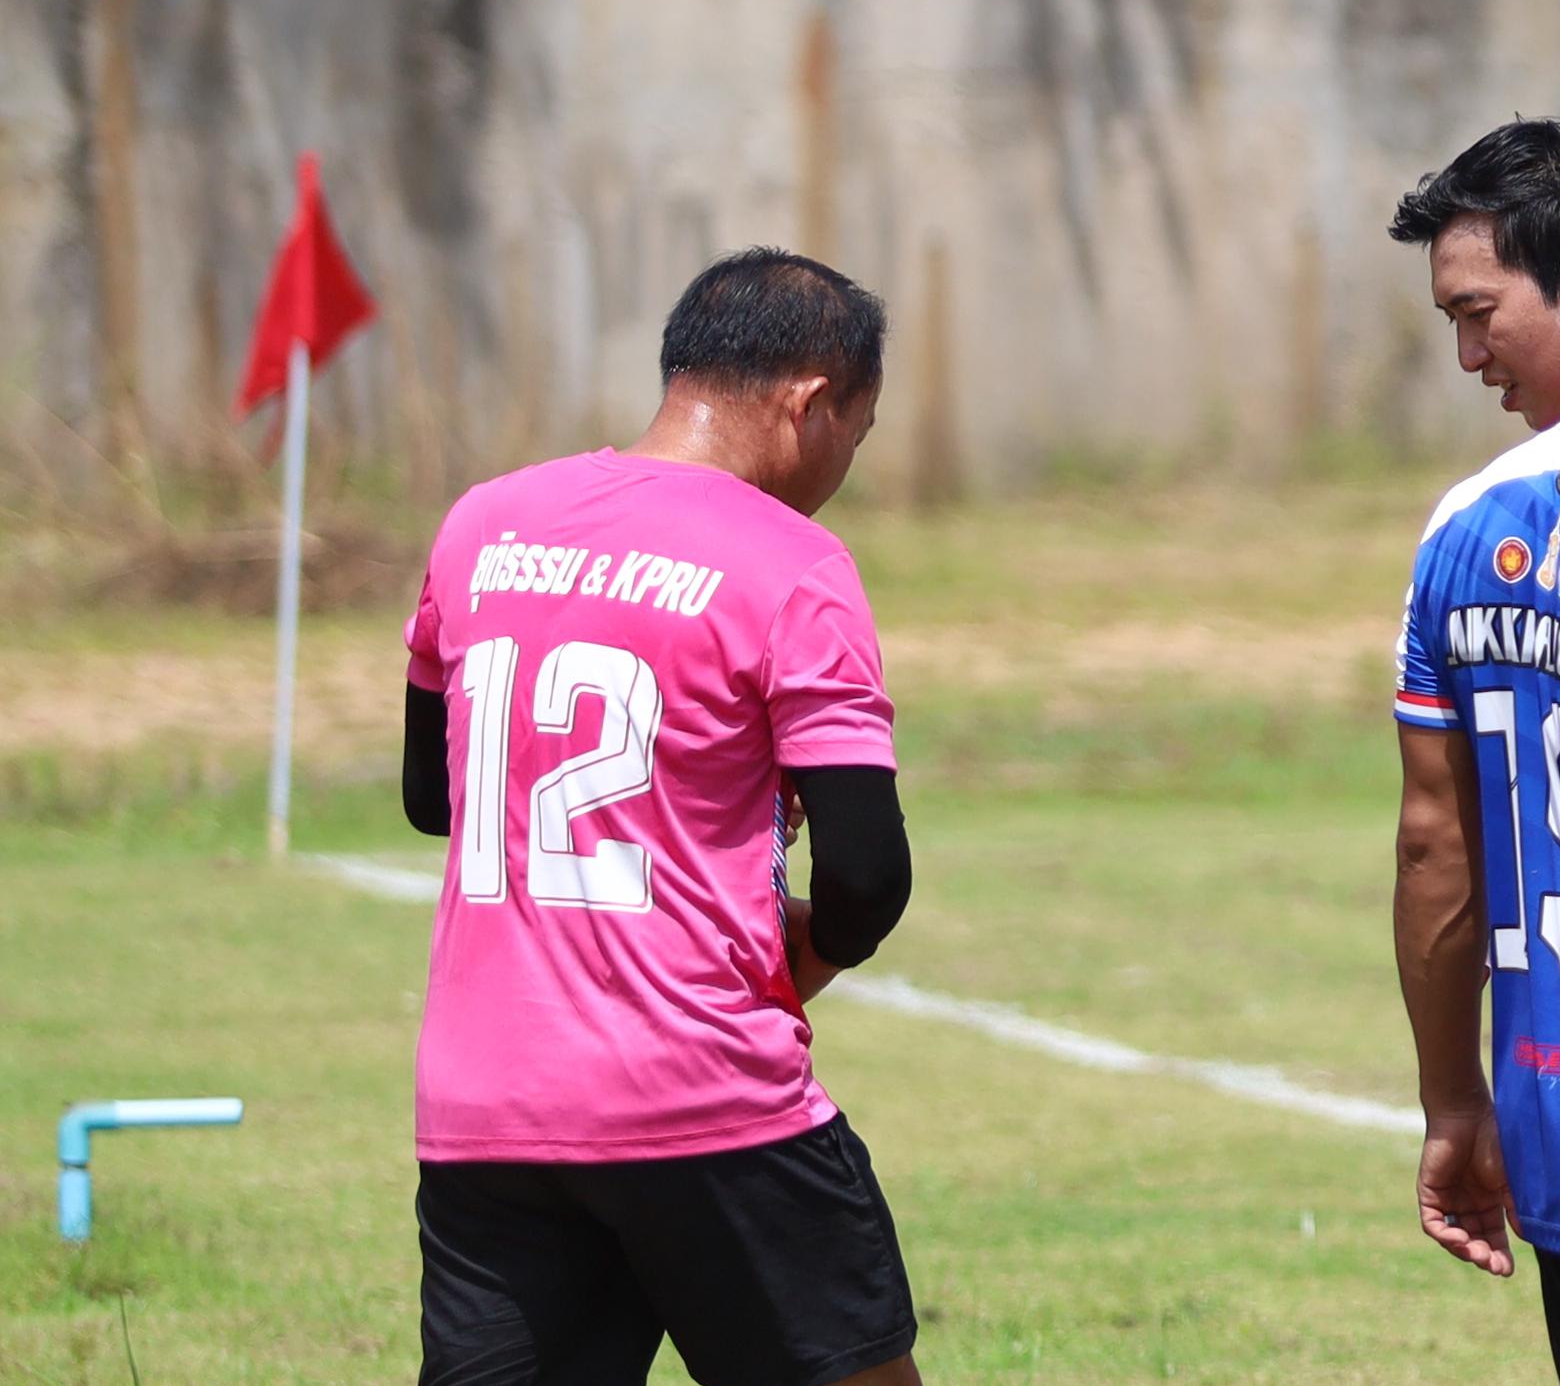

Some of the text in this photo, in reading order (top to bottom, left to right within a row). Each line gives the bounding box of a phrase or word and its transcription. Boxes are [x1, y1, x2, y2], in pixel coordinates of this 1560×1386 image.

[580, 553, 612, 596] &
[605, 550, 725, 617] KPRU
[460, 635, 664, 913] 12
